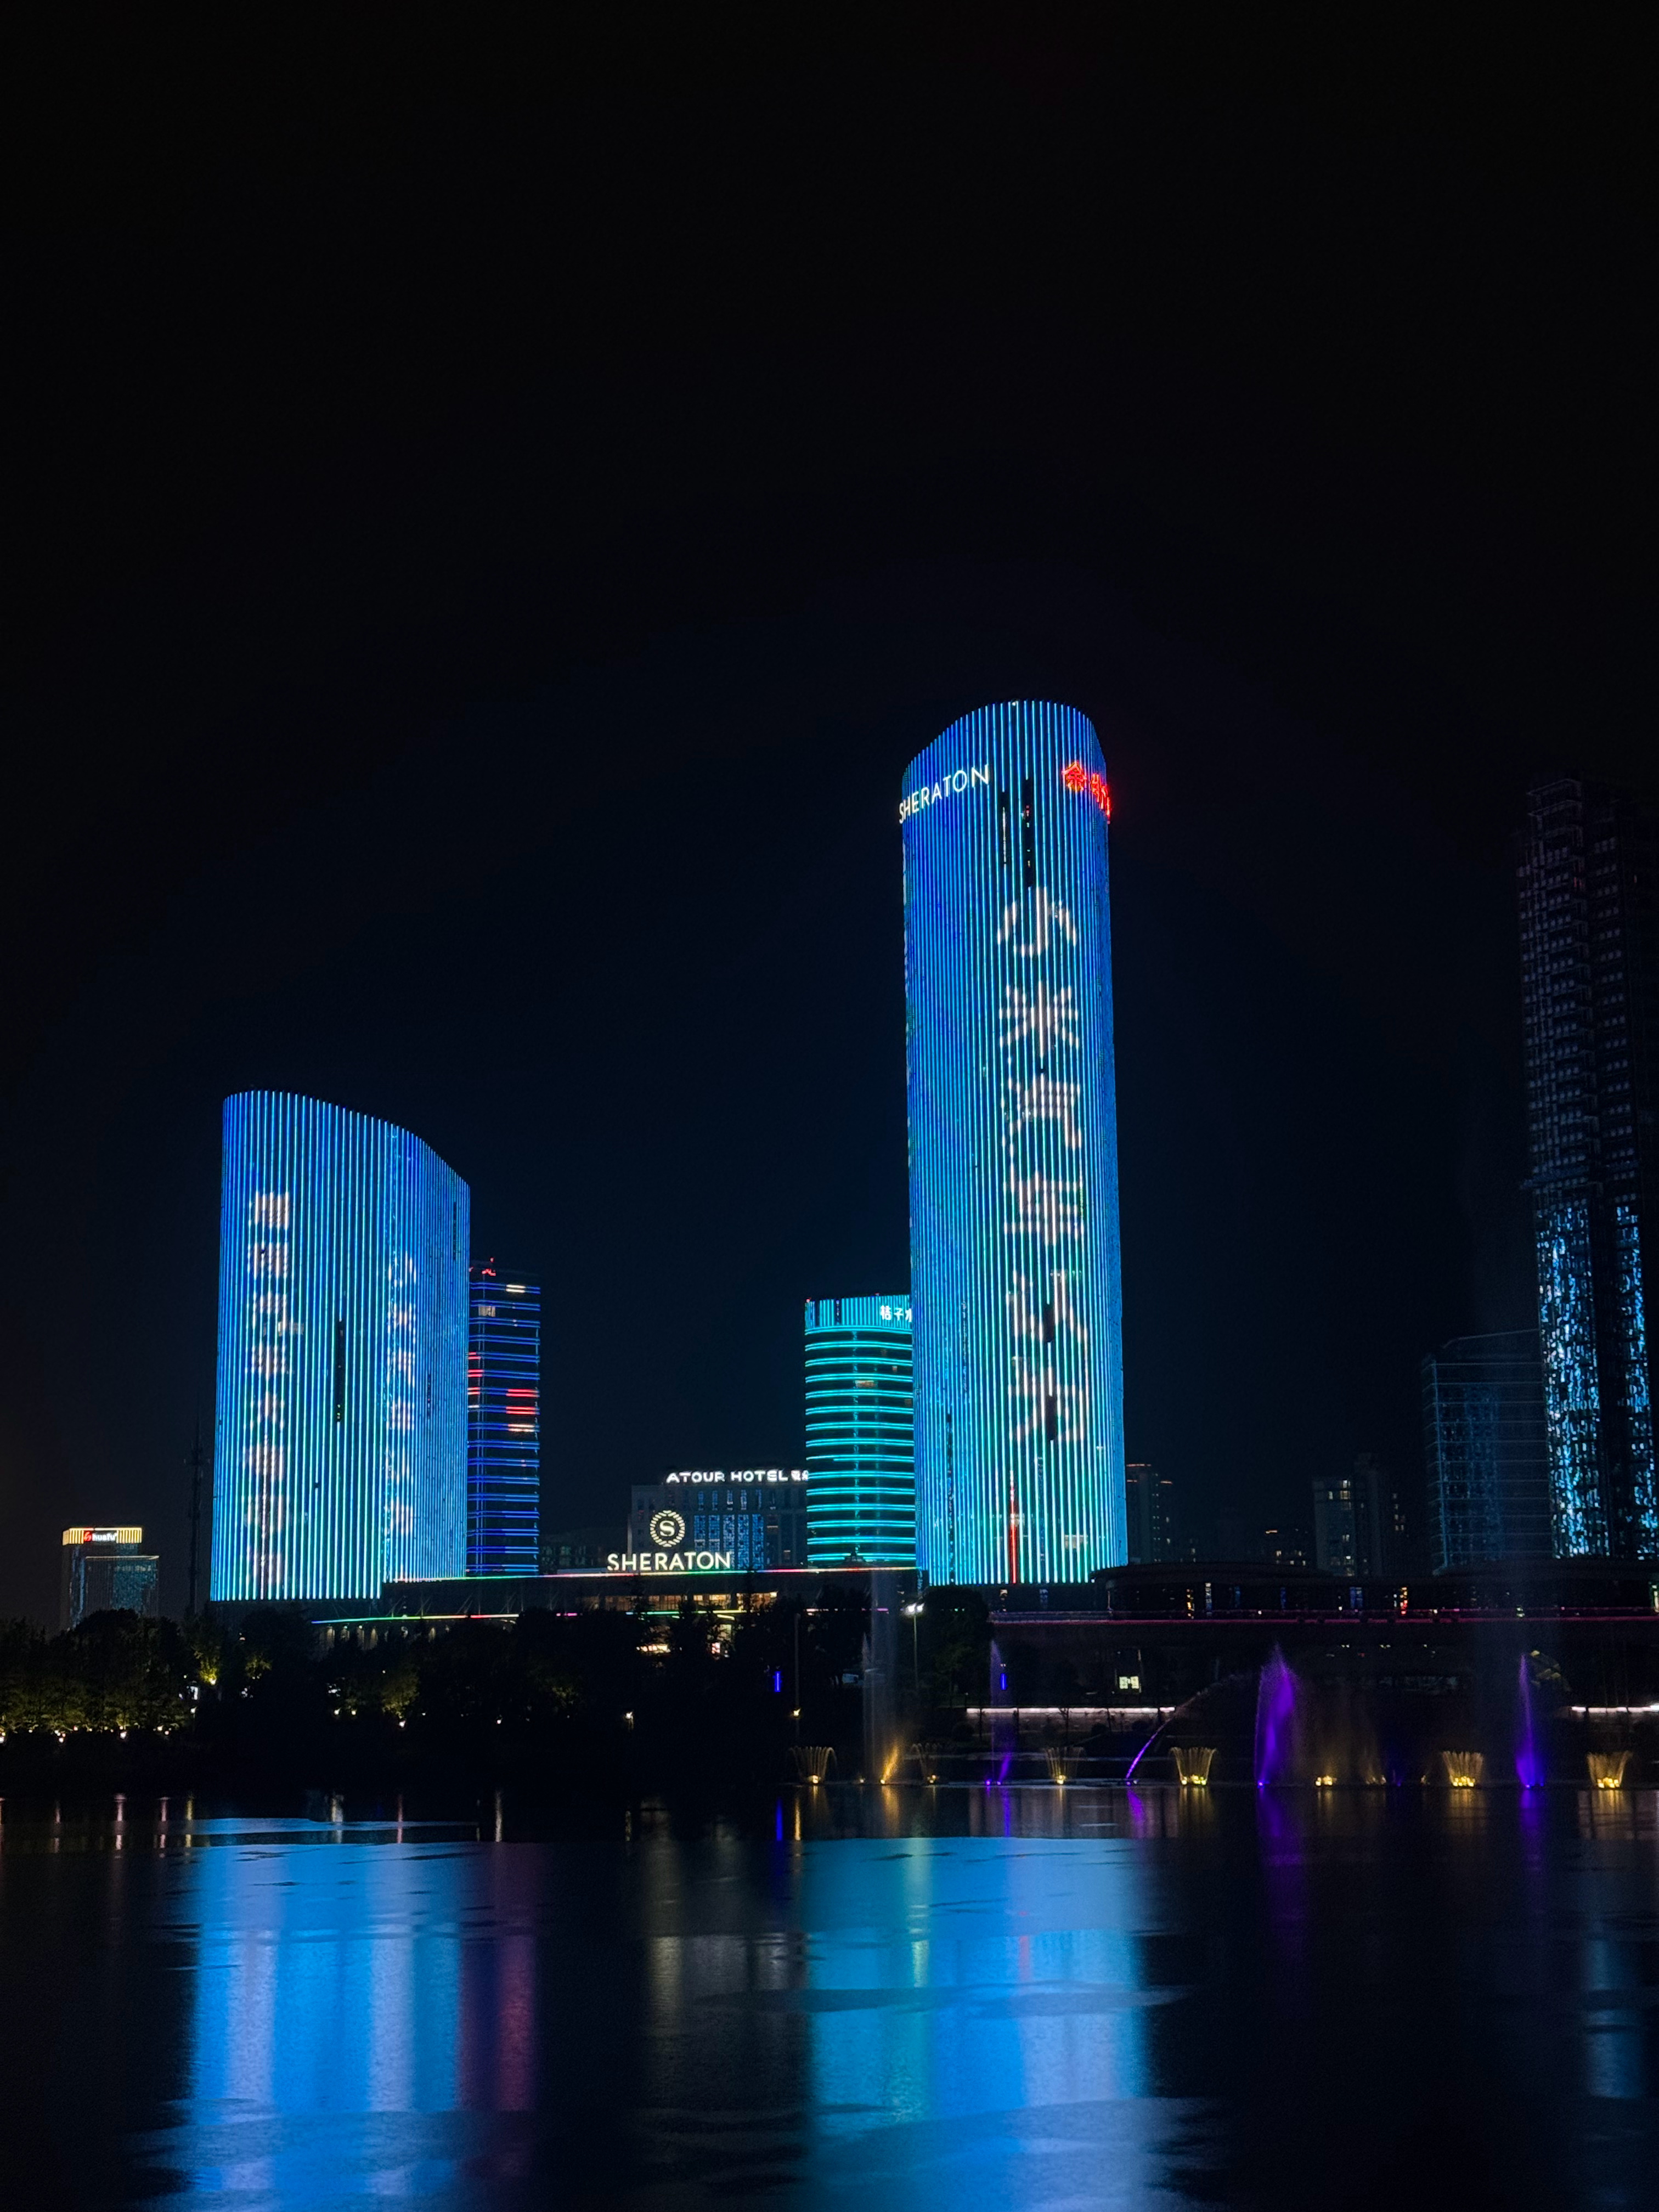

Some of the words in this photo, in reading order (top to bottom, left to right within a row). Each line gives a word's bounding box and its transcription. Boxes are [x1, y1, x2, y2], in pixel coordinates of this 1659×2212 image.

[899, 764, 990, 824] SHERATON
[666, 1471, 725, 1483] ATOUR
[730, 1470, 788, 1482] HOTEL
[607, 1551, 731, 1571] SHERATON
